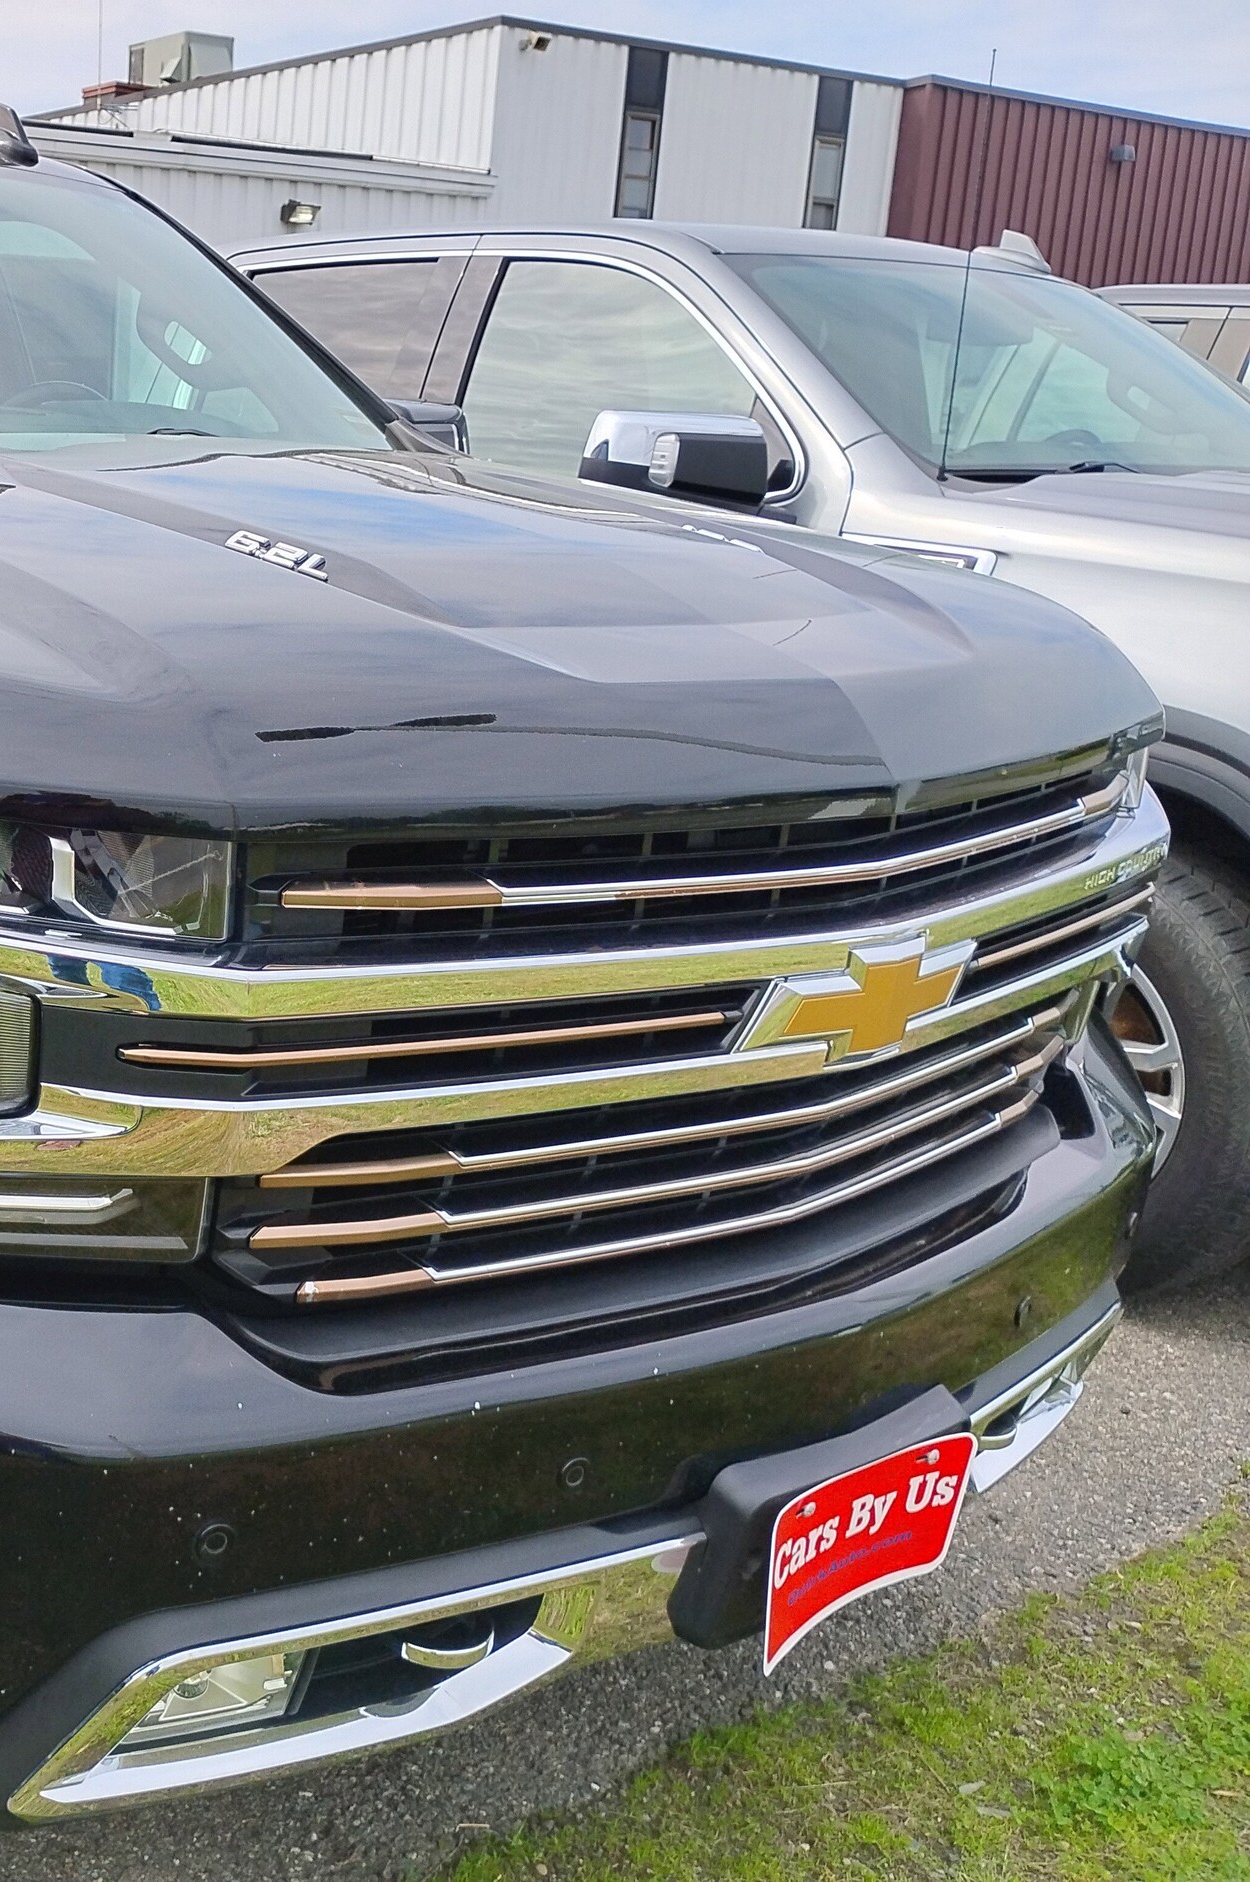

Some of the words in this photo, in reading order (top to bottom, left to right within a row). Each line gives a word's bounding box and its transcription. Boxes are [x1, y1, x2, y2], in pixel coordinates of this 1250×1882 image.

[224, 529, 329, 582] 6.2L
[1084, 867, 1116, 890] HIGH
[774, 1516, 840, 1589] Cars
[845, 1490, 898, 1538] By
[905, 1471, 958, 1514] Us
